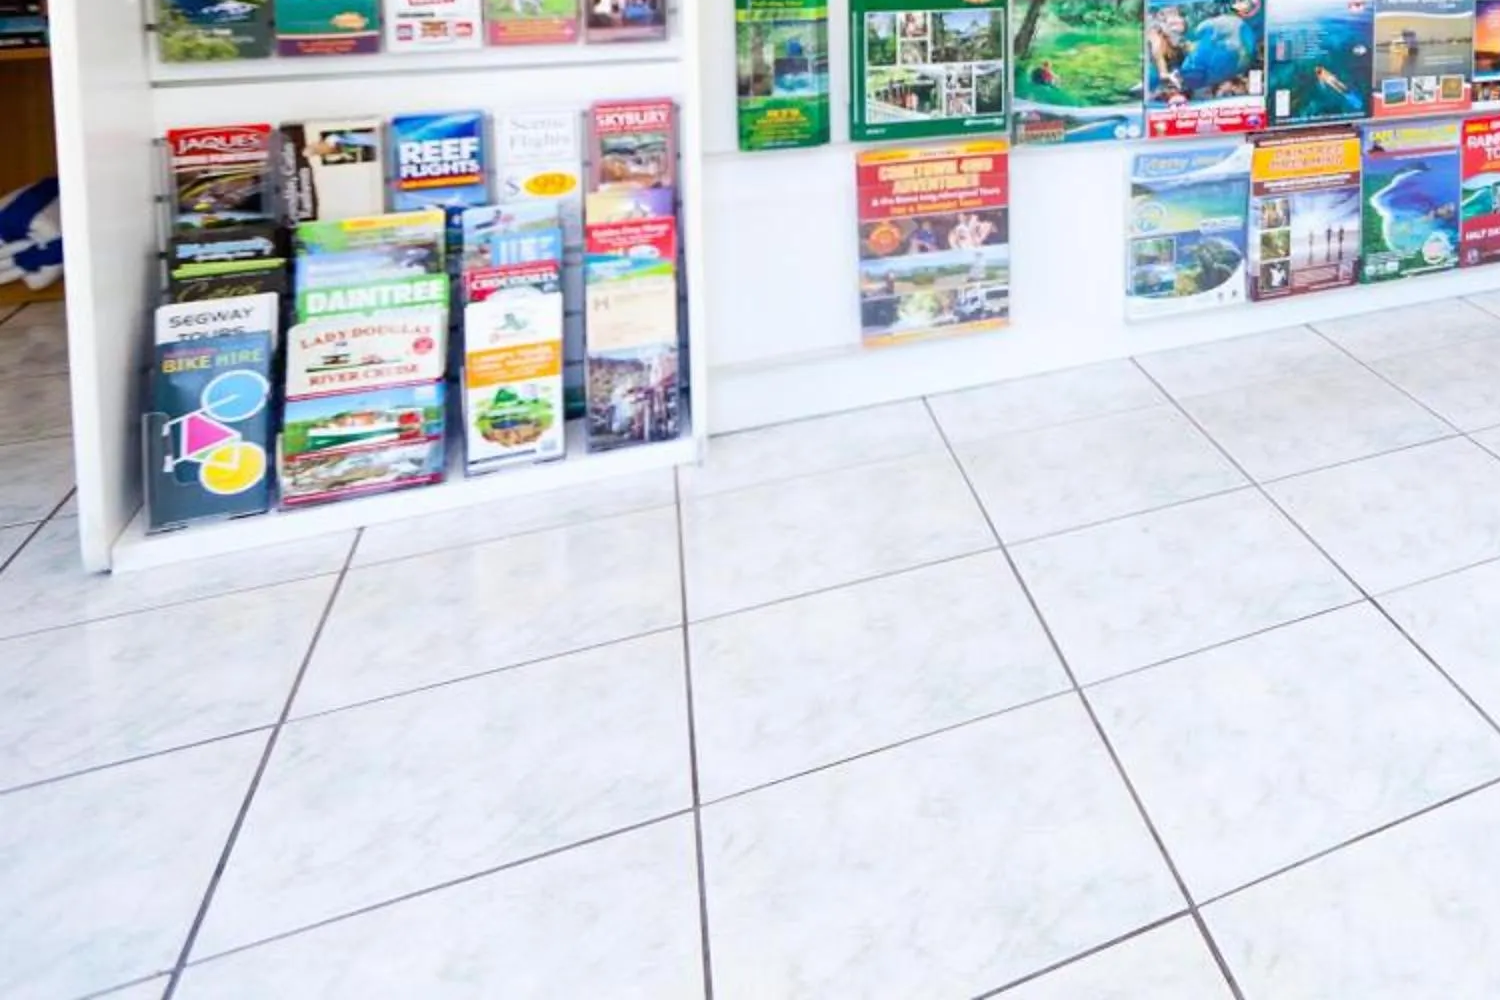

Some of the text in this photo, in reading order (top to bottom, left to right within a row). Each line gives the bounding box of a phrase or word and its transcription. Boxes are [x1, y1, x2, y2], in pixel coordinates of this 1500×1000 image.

[179, 133, 261, 154] JAQUES
[400, 137, 479, 164] REEF
[400, 161, 480, 179] FLIGHTS
[306, 282, 445, 313] DAINTREE
[169, 306, 255, 328] SEGWAY
[301, 330, 346, 350] LADY
[162, 349, 264, 373] BIKE HIRE
[310, 370, 358, 386] RIVER
